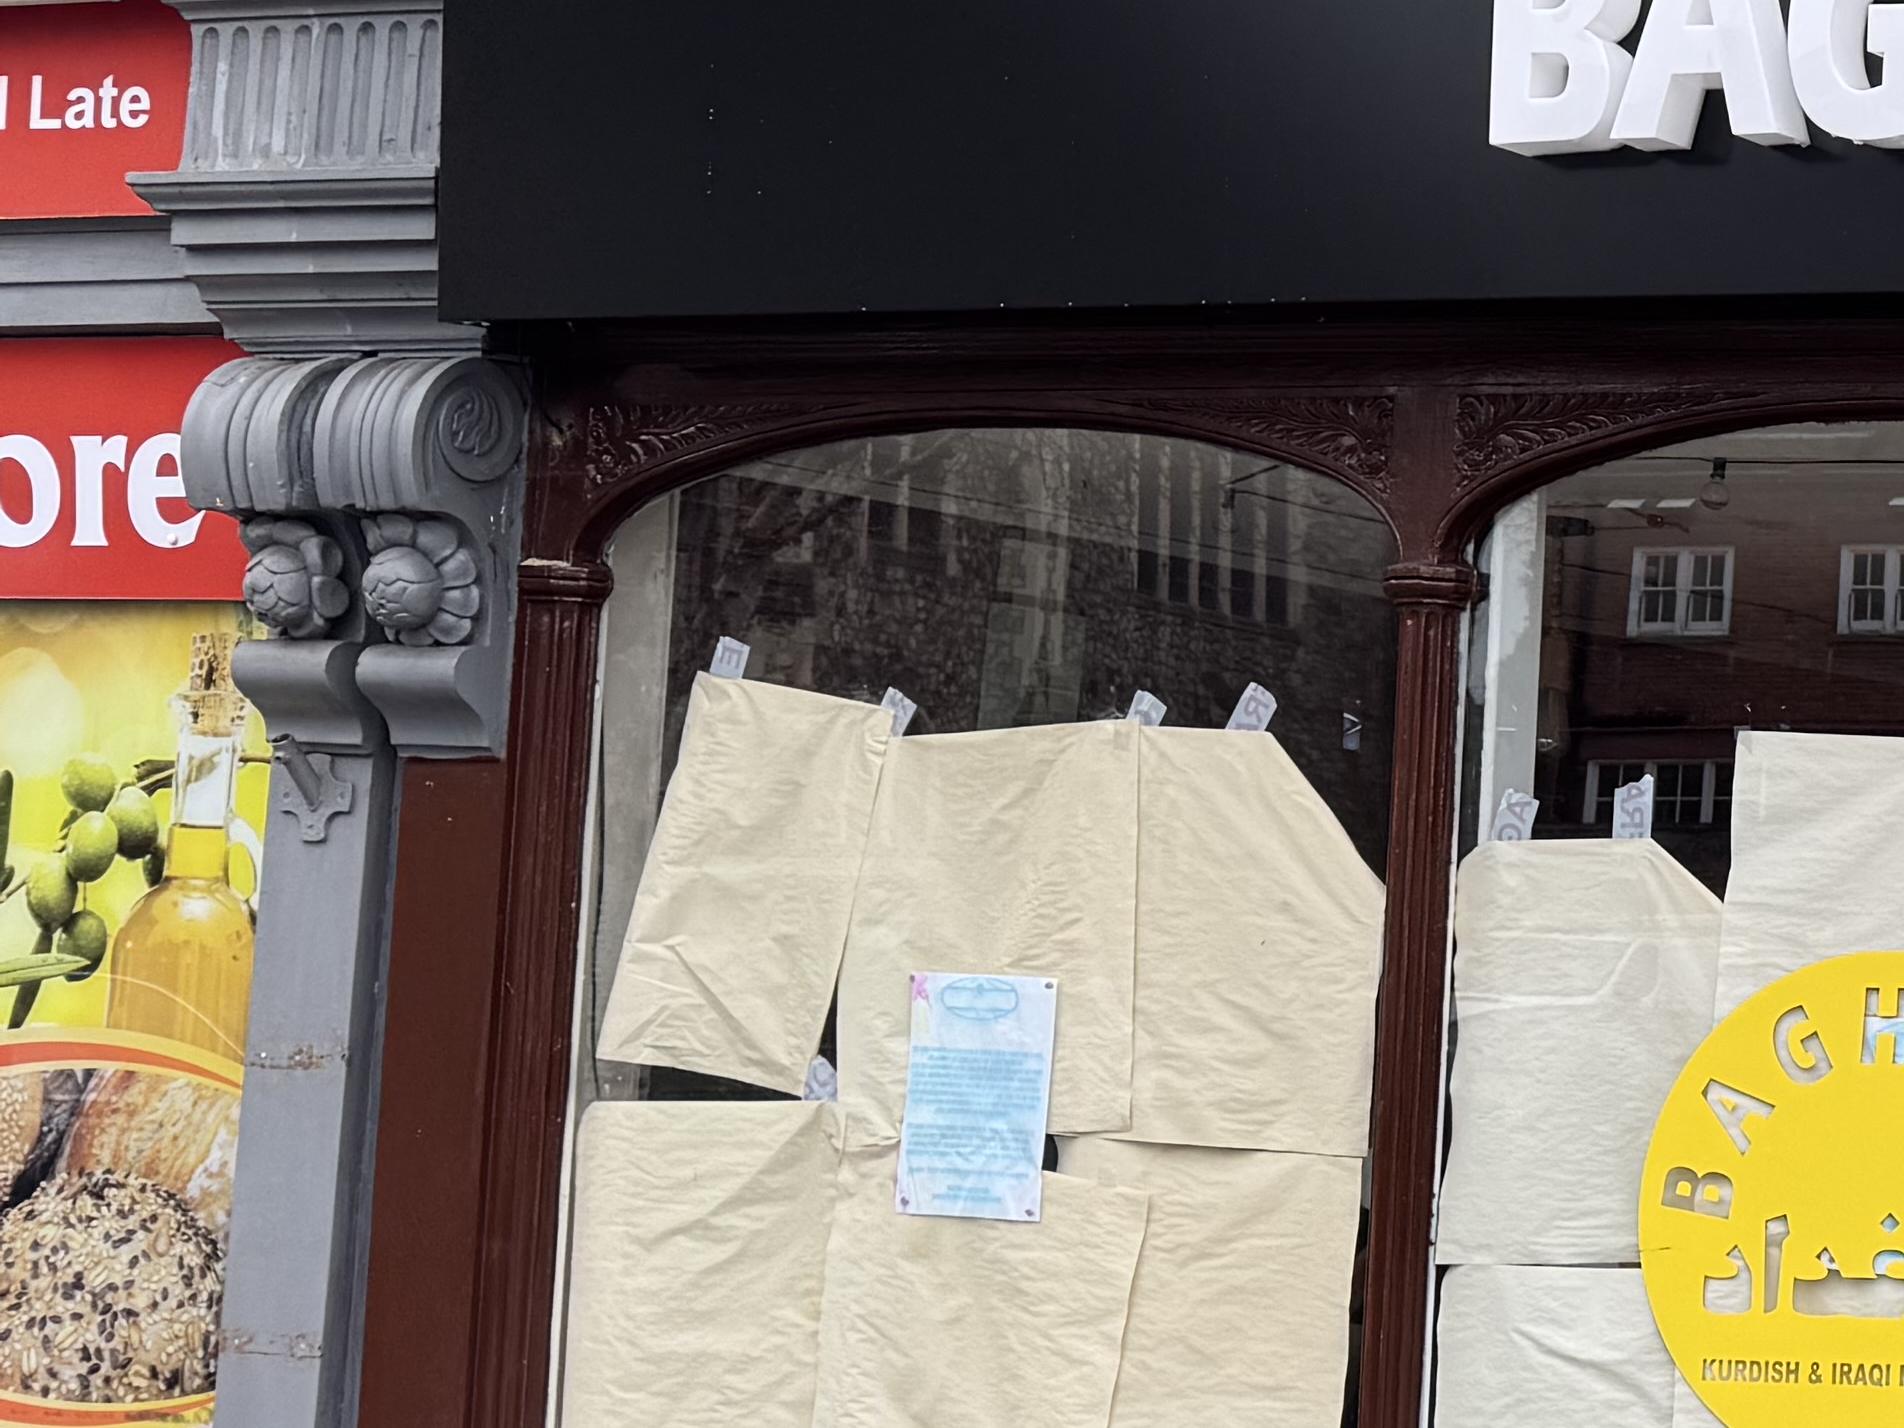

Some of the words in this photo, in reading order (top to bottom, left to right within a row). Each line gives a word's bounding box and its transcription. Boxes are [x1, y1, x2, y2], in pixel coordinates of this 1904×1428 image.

[29, 74, 151, 130] Late
[0, 432, 205, 548] ore
[1702, 1358, 1800, 1384] KURDISH
[1808, 1364, 1823, 1384] &
[1831, 1363, 1892, 1388] IRAQI
